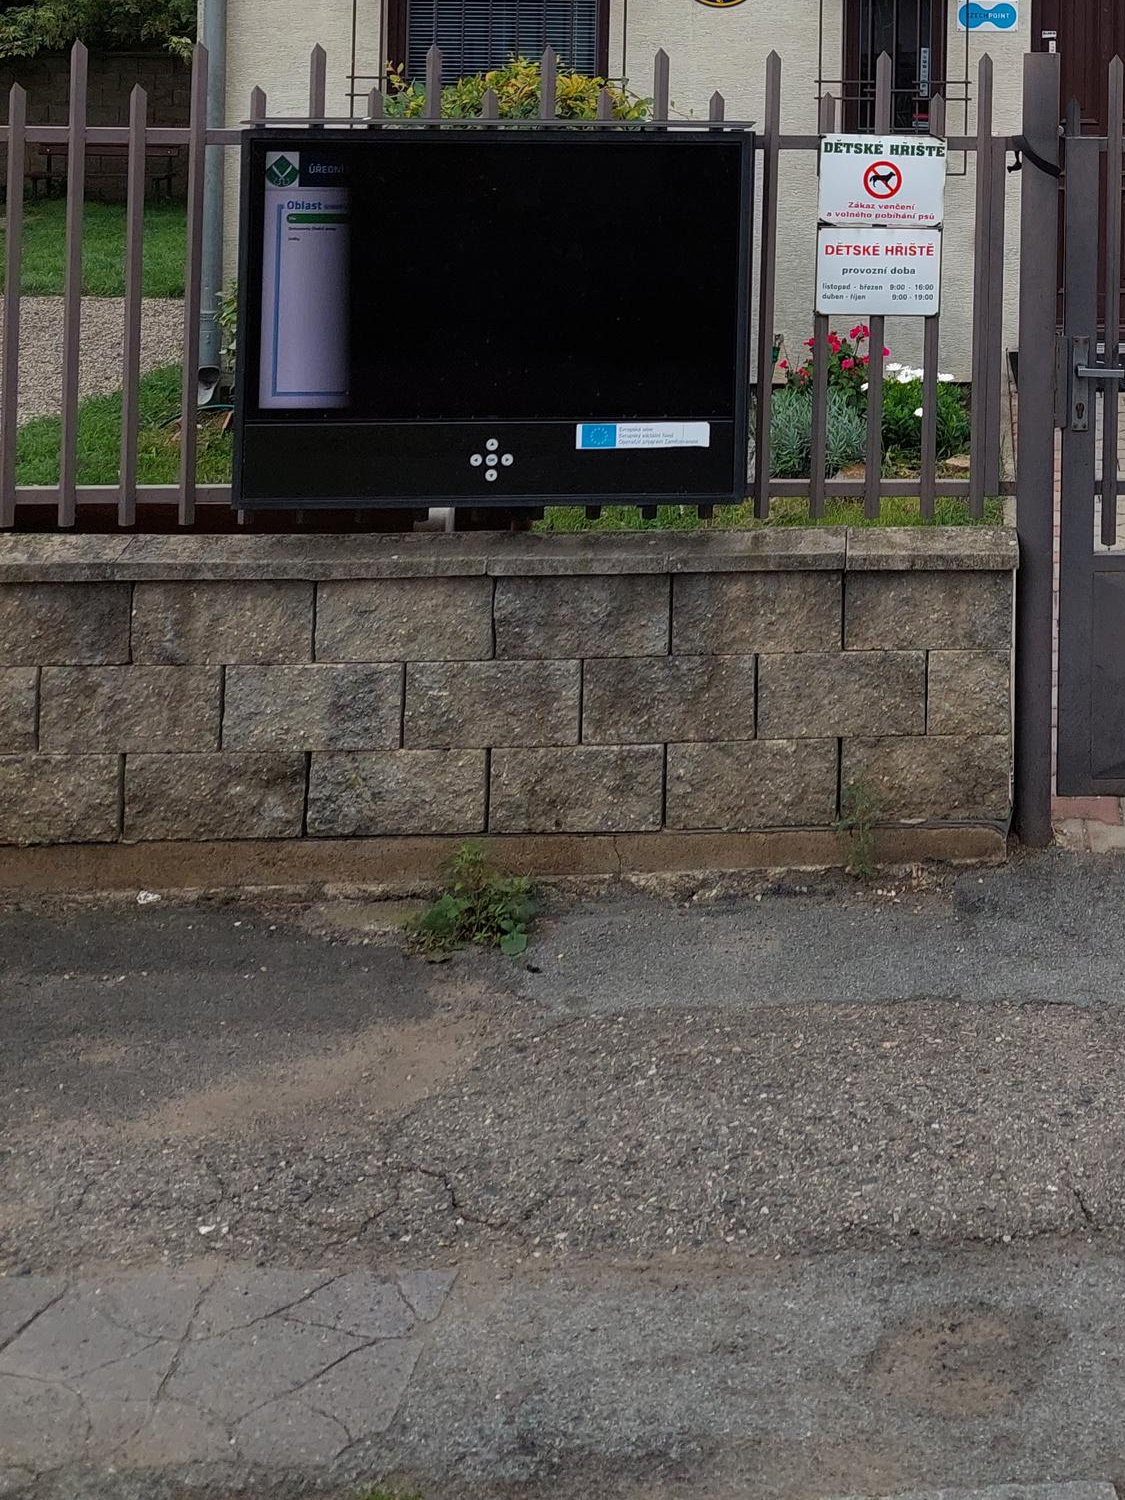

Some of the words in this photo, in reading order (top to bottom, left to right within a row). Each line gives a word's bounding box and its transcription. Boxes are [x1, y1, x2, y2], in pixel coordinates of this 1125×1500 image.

[823, 139, 884, 155] DĚTSKÉ
[889, 141, 945, 157] HŘIŠTĚ
[286, 201, 322, 210] Oblast
[848, 201, 876, 209] Zákaz
[878, 203, 916, 211] venčení
[835, 211, 872, 219] volného
[875, 212, 916, 220] pobíhání
[825, 243, 880, 256] DĚTSKÉ
[885, 243, 935, 256] HŘIŠTĚ
[841, 266, 887, 276] provozní
[890, 266, 916, 275] doba
[822, 283, 851, 291] listopad
